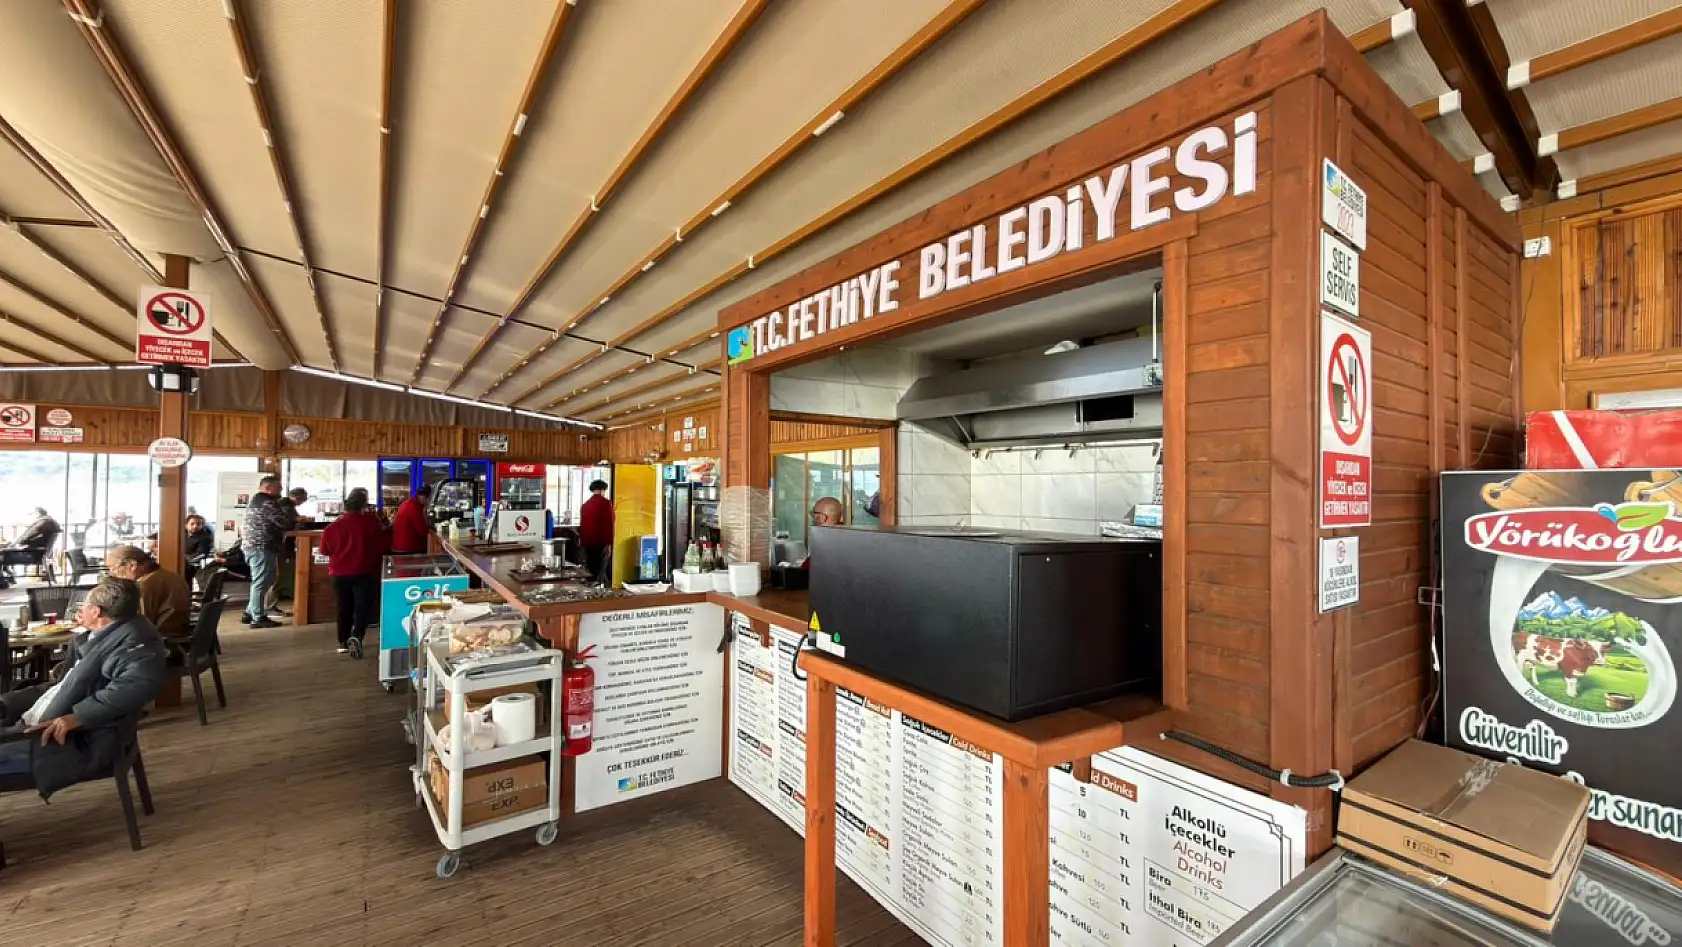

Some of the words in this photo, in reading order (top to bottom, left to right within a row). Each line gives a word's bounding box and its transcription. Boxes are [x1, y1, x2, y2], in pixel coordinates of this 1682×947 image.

[1332, 246, 1353, 278] SELF
[1327, 271, 1357, 306] SERVİS
[953, 736, 969, 752] Cold
[1463, 709, 1563, 761] Güvenilir
[607, 762, 622, 775] ÇOK
[624, 753, 660, 770] TEŞEKKÜR
[1101, 774, 1134, 798] Drinks
[1119, 808, 1130, 821] TL
[1171, 805, 1226, 839] Alkollü
[1119, 831, 1130, 845] TL
[1165, 813, 1236, 859] İçecekler
[1119, 855, 1130, 869] TL
[1173, 840, 1227, 874] Alcohol
[1052, 858, 1085, 883] Kahvesi
[1119, 897, 1130, 911] TL
[1119, 873, 1130, 887] TL
[1149, 866, 1171, 886] Bira
[1177, 856, 1223, 889] Drinks
[1149, 889, 1174, 914] İthal
[1177, 907, 1201, 929] Bira
[1119, 921, 1130, 936] TL
